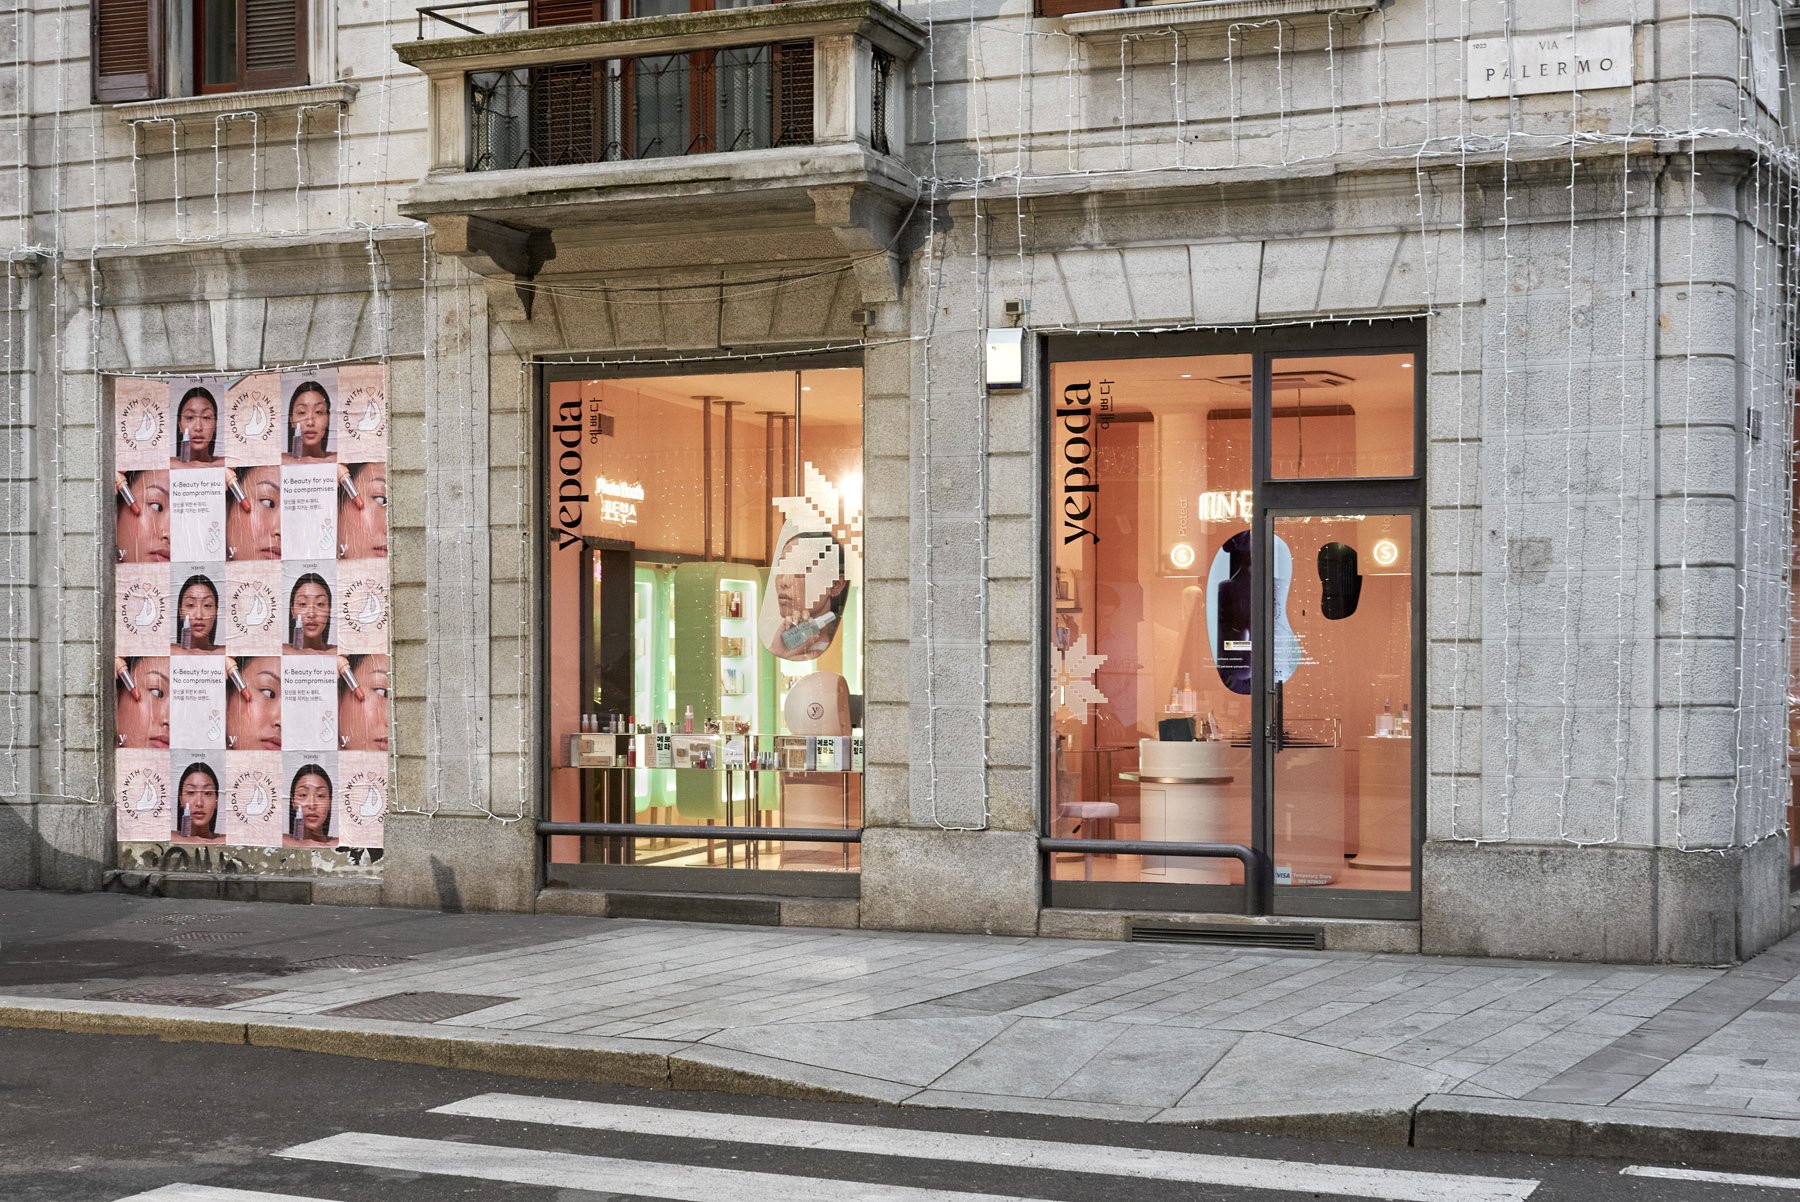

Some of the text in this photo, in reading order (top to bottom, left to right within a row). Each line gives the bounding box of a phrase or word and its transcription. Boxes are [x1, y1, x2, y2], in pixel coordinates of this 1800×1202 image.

[1538, 41, 1559, 50] VIA
[1486, 58, 1613, 82] PALERMO
[345, 388, 363, 406] WITH
[377, 390, 384, 400] IN
[1099, 378, 1115, 430] 예쁘다
[121, 399, 164, 450] YEPODA WITH IN MILANO
[230, 392, 277, 445] YEPODA WITH IN MILANO
[343, 410, 360, 440] YEPODA
[589, 397, 602, 444] 예쁘다
[552, 397, 589, 552] yepoda
[1056, 380, 1100, 545] yepoda
[283, 478, 310, 486] K-Beauty
[1179, 498, 1188, 536] Protect
[345, 580, 363, 598] WITH
[376, 584, 384, 593] IN
[122, 583, 166, 635] YEPODA WITH IN MILANO
[231, 582, 277, 634] YEPODA WITH IN MILANO
[343, 602, 361, 632] YEPODA
[122, 769, 166, 820] YEPODA WITH IN MILANO
[346, 772, 364, 790] WITH
[377, 777, 387, 786] IN
[232, 772, 277, 824] YEPODA WITH IN MILANO
[345, 794, 362, 825] YEPODA
